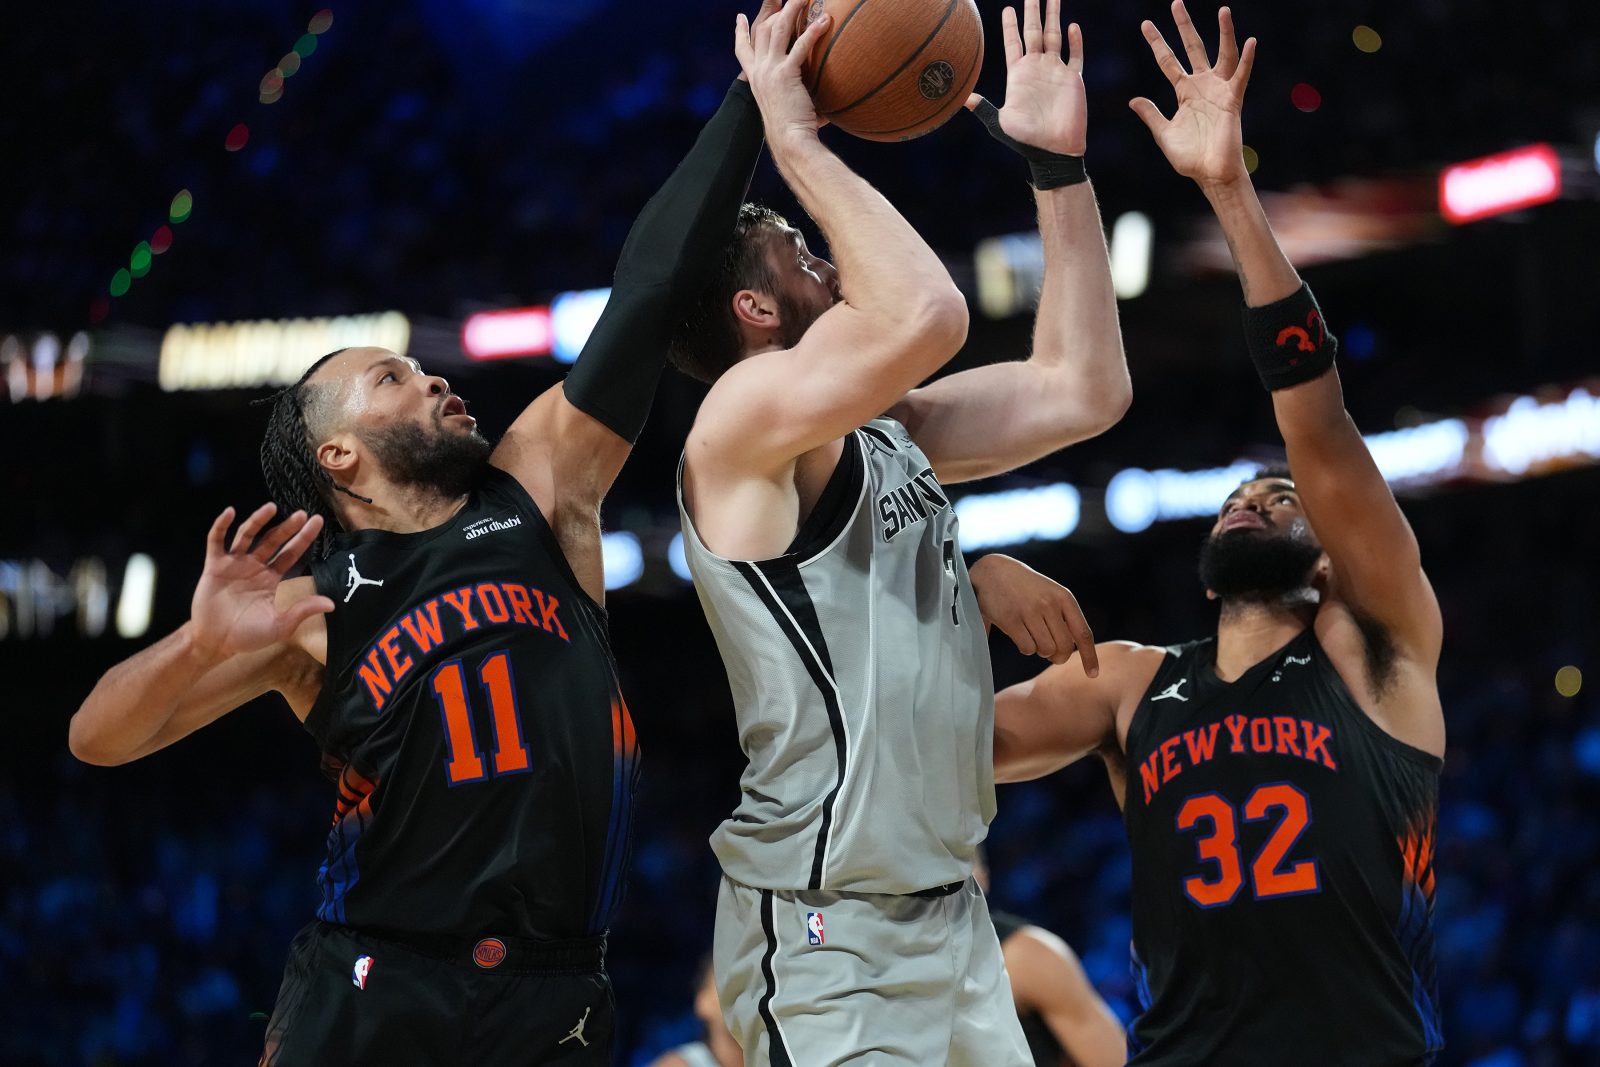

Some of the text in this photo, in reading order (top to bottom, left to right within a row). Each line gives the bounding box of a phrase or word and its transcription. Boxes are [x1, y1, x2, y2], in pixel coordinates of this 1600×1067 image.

[463, 517, 493, 531] experience
[466, 515, 522, 540] abu dhabi
[356, 582, 571, 713] NEW YORK
[429, 650, 533, 787] 11
[1138, 714, 1338, 805] NEW YORK
[1175, 780, 1322, 909] 32
